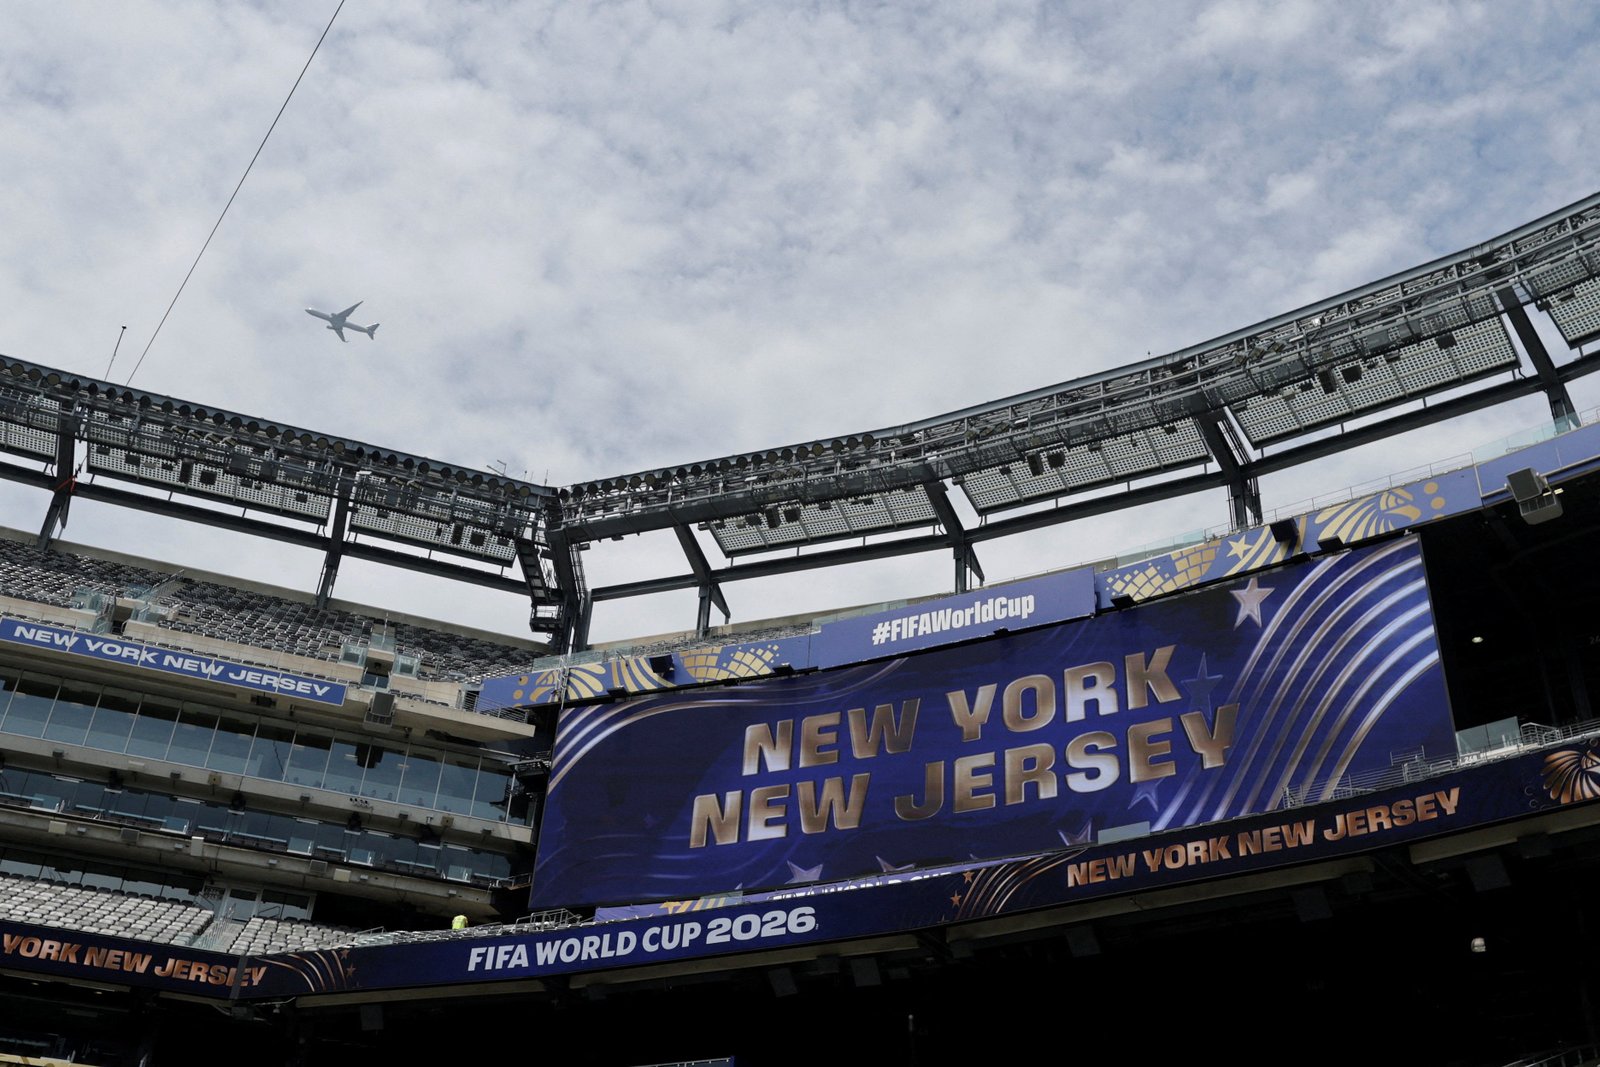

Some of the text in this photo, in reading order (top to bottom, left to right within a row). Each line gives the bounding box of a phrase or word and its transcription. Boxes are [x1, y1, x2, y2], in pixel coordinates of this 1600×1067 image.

[872, 595, 1035, 646] #FIFAWorldCup
[14, 625, 331, 697] NEW YORK NEW JERSEY
[742, 645, 1182, 776] NEW YORK
[689, 703, 1241, 849] NEW JERSEY
[1067, 787, 1460, 888] NEW YORK NEW JERSEY
[3, 933, 268, 987] YORK NEW JERSEY
[467, 906, 817, 972] FIFA WORLD CUP 2026
